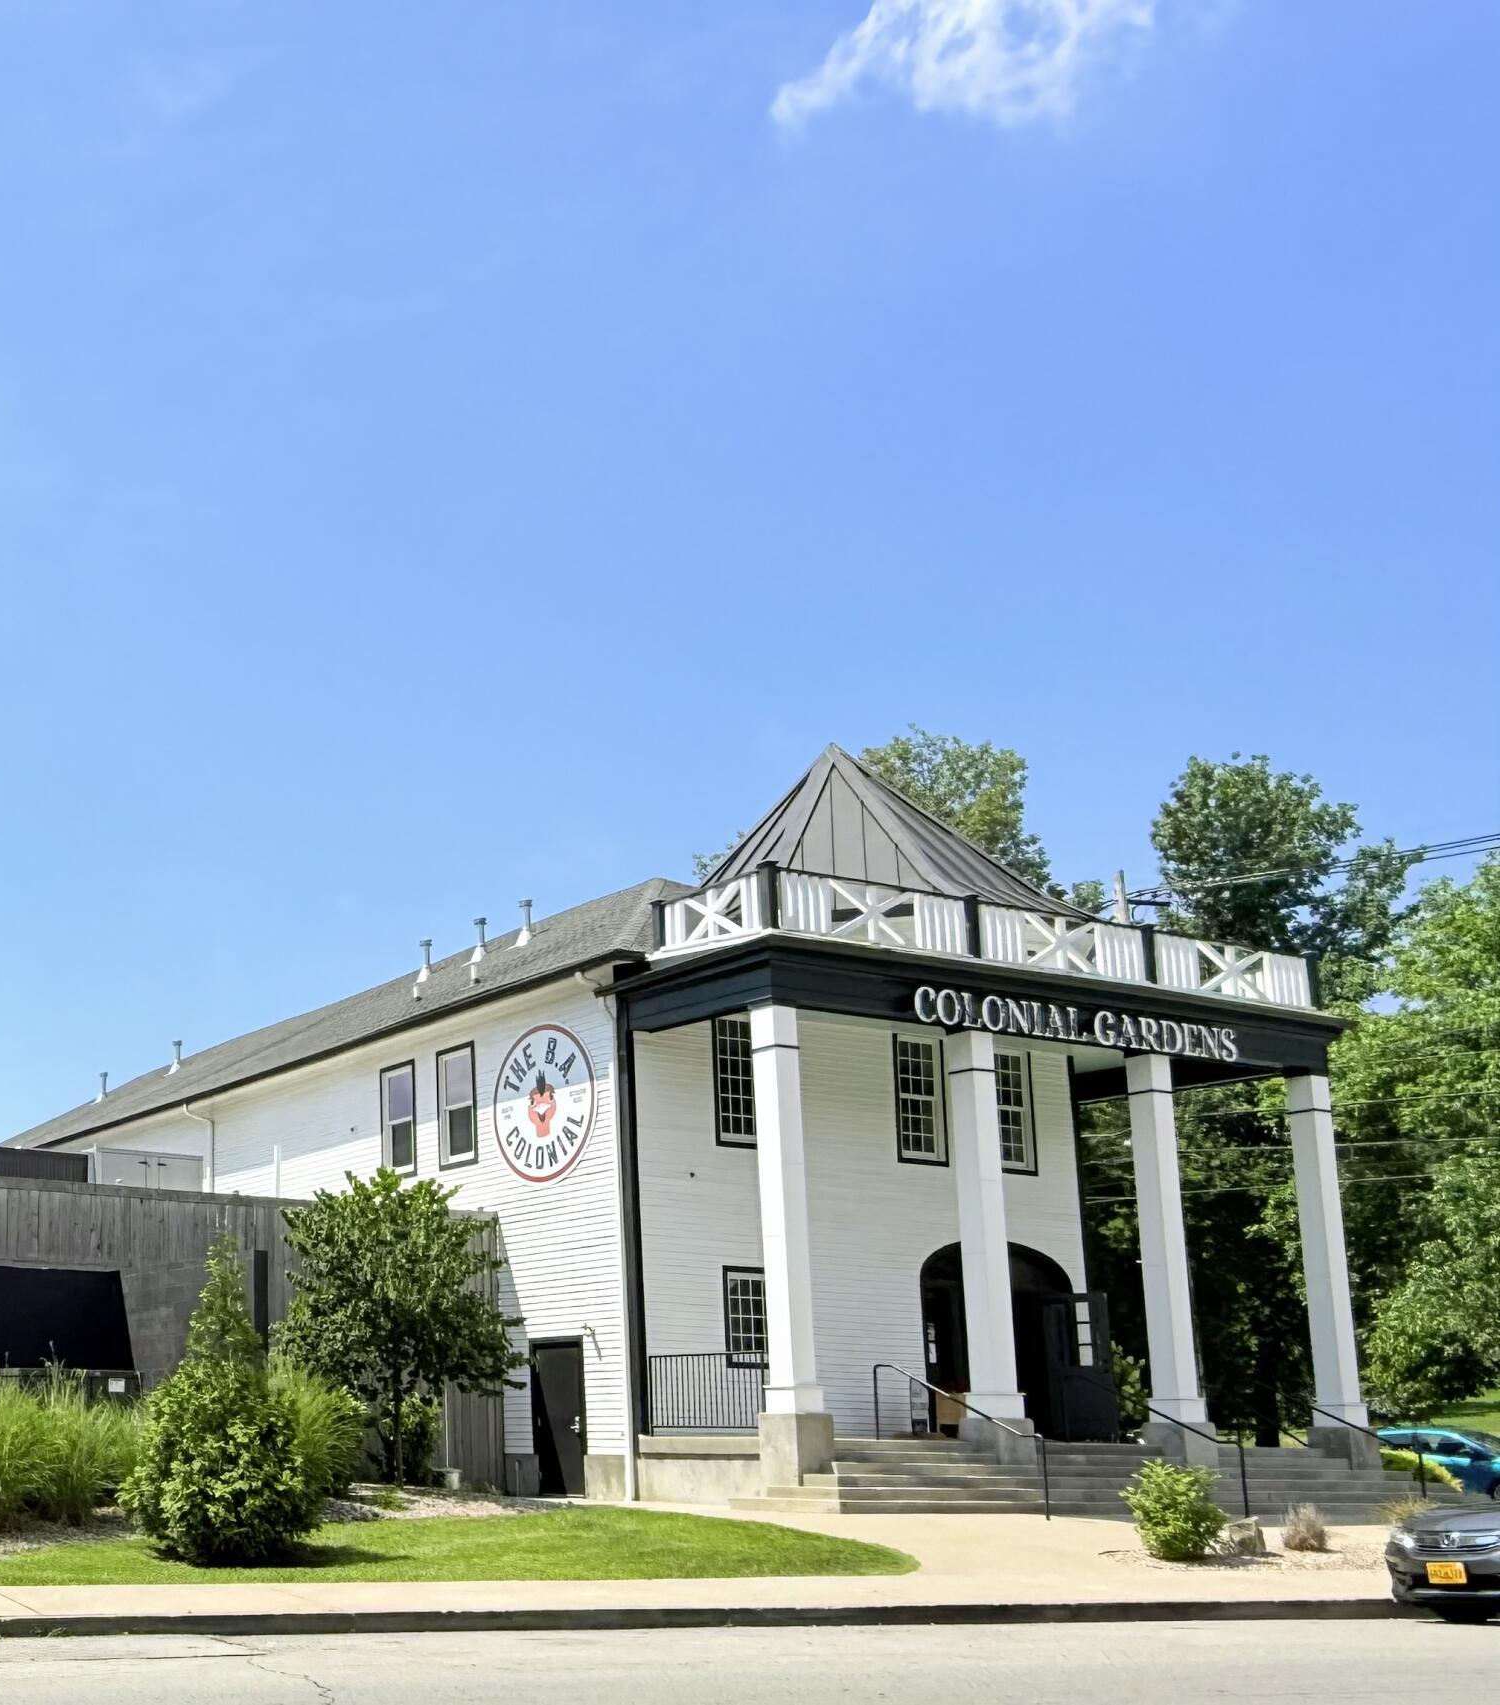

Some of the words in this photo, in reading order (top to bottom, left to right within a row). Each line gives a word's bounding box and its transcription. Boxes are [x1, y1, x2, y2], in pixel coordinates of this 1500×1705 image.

[913, 985, 1087, 1041] COLONIAL
[1094, 1010, 1237, 1062] GARDENS
[503, 1042, 536, 1092] THE
[505, 1114, 585, 1170] COLONIAL
